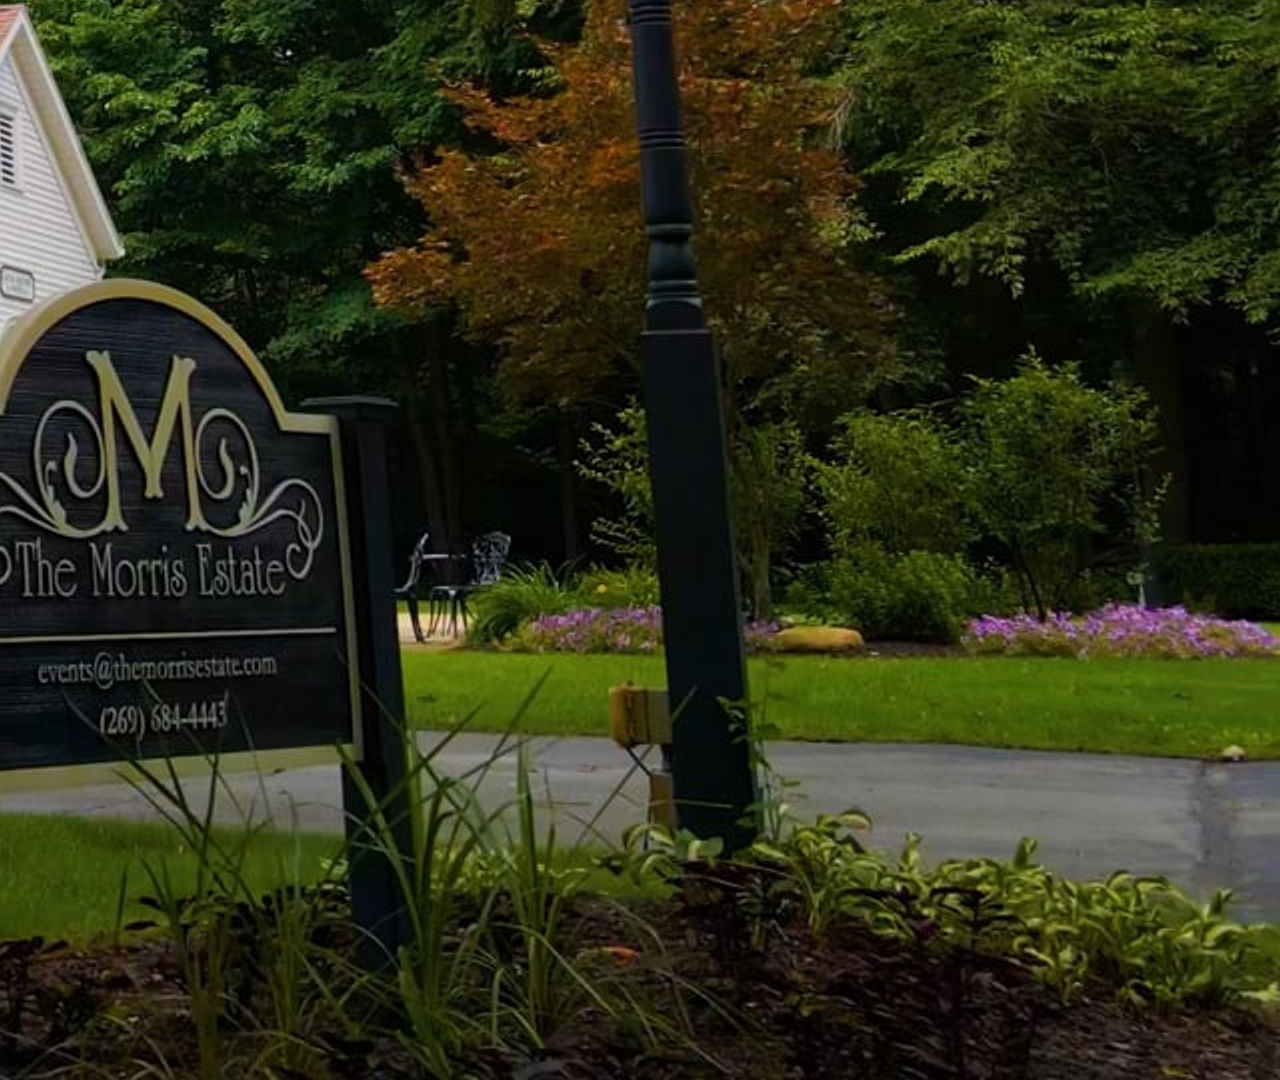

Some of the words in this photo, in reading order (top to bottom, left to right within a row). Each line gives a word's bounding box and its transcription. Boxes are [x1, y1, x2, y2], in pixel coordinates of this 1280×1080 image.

[85, 350, 196, 532] M
[15, 536, 77, 598] The
[89, 541, 188, 598] Morris
[195, 543, 286, 596] Estate
[37, 650, 278, 690] events@themorrisestate.com
[99, 704, 146, 742] (269)
[150, 700, 228, 733] 684-4443
